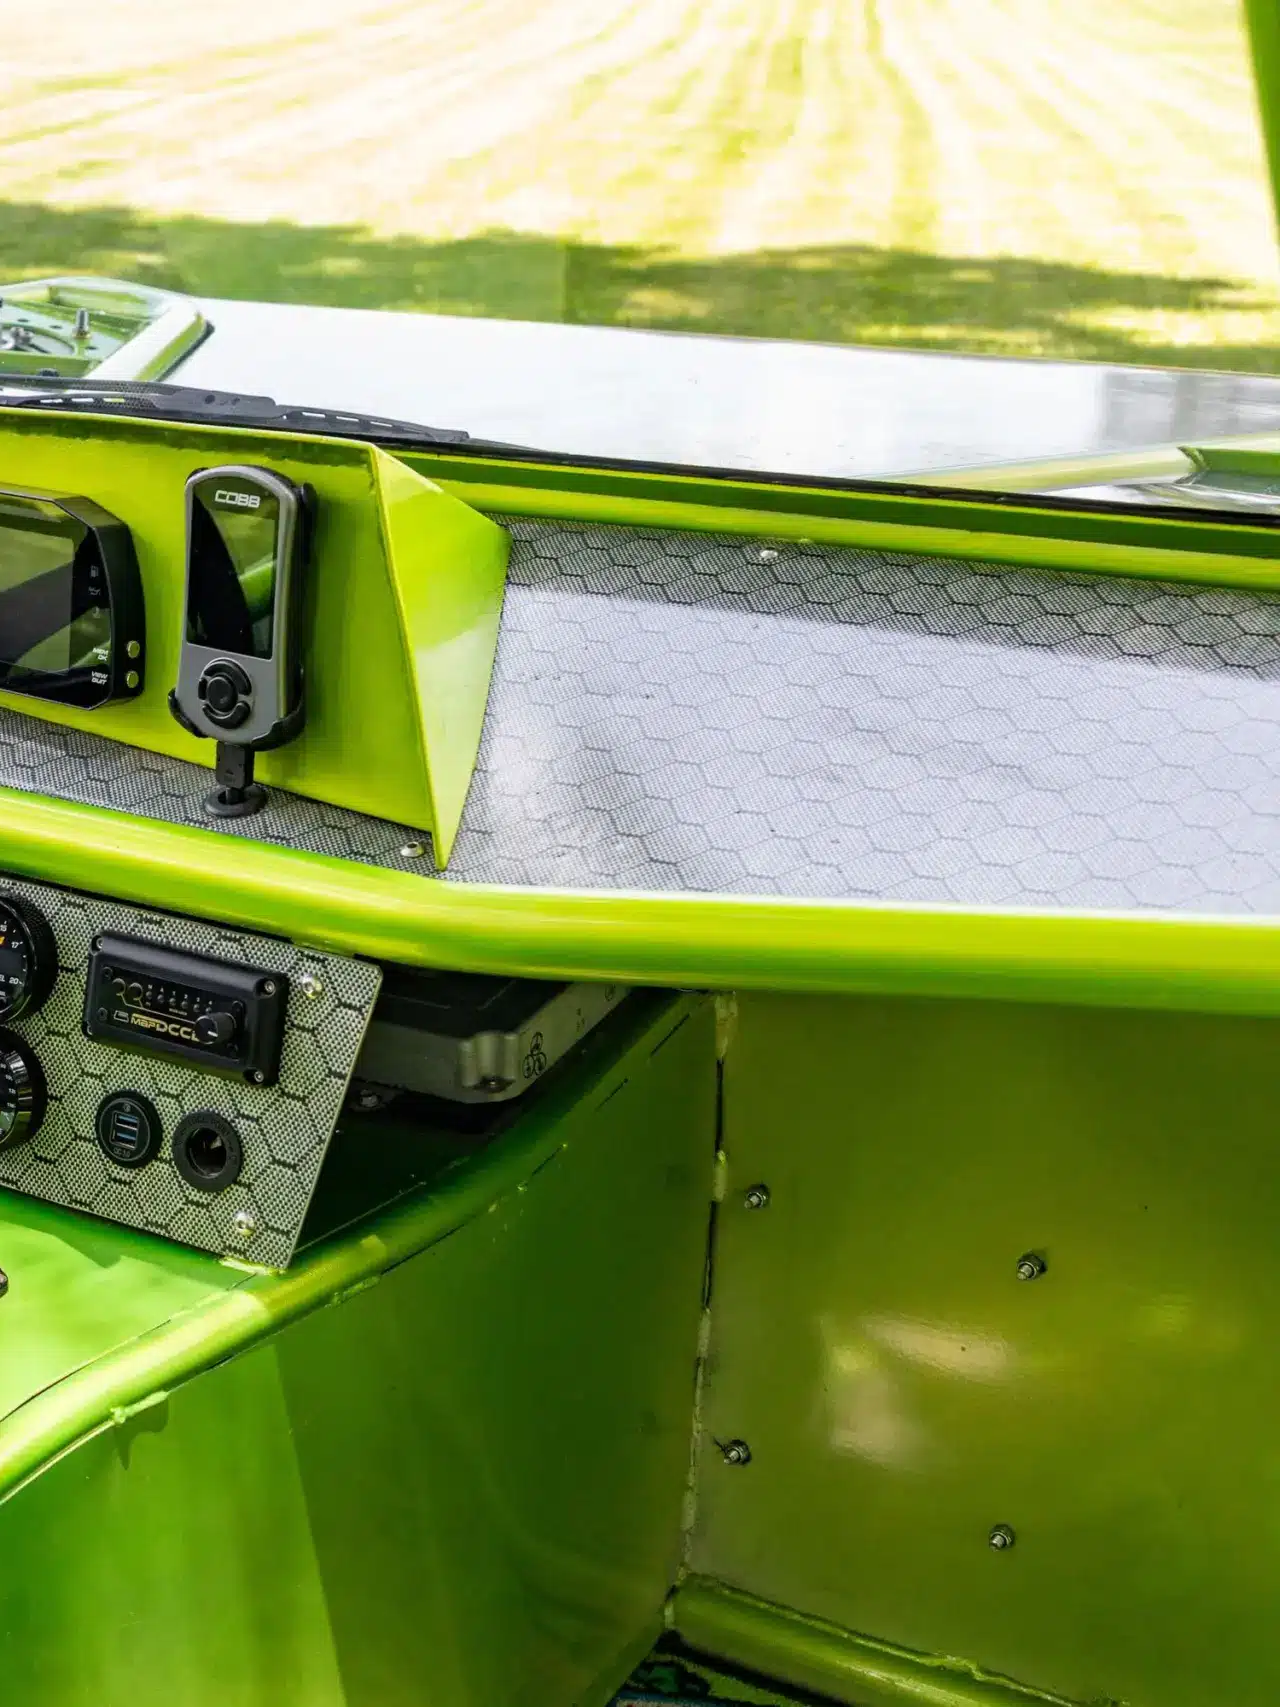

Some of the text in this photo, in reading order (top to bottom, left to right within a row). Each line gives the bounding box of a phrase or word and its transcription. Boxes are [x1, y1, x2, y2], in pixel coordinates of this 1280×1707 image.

[215, 490, 261, 508] COBB
[11, 941, 20, 949] 17
[9, 977, 20, 985] 20
